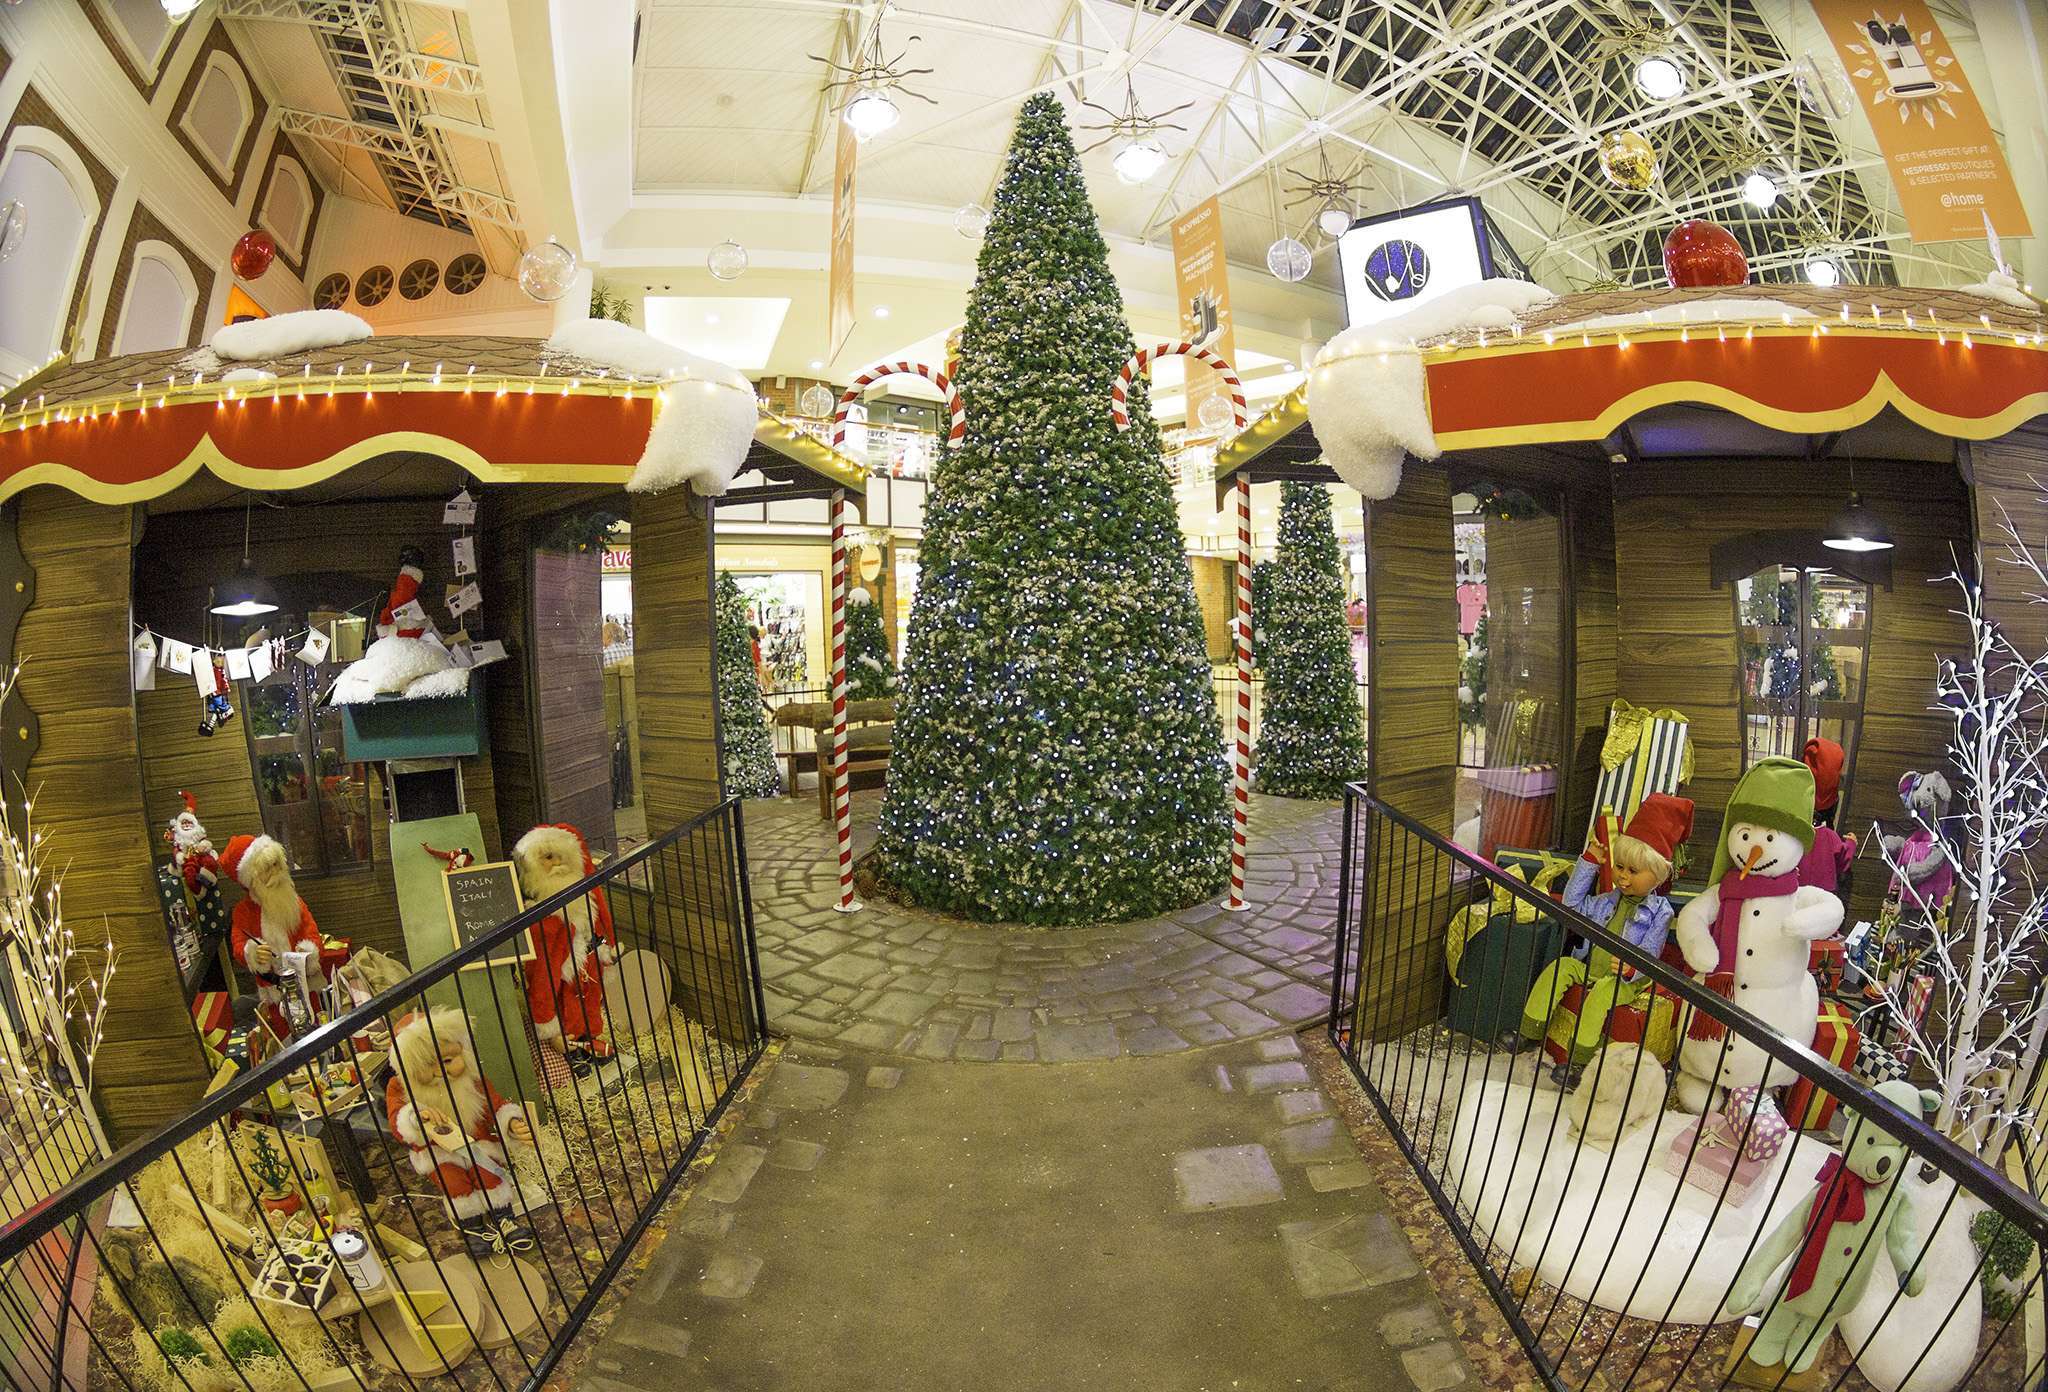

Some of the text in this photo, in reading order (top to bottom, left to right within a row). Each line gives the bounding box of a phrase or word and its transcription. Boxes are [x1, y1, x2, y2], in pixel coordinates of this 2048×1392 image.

[1929, 147, 1961, 157] PERFECT
[1903, 160, 1996, 176] NESPRESSO BOUTIQUES
[1917, 174, 1956, 184] SELECTED
[1957, 171, 1996, 181] PARTNERS
[1940, 191, 1985, 208] @home
[456, 877, 493, 891] SPAIN
[465, 919, 496, 931] ROME
